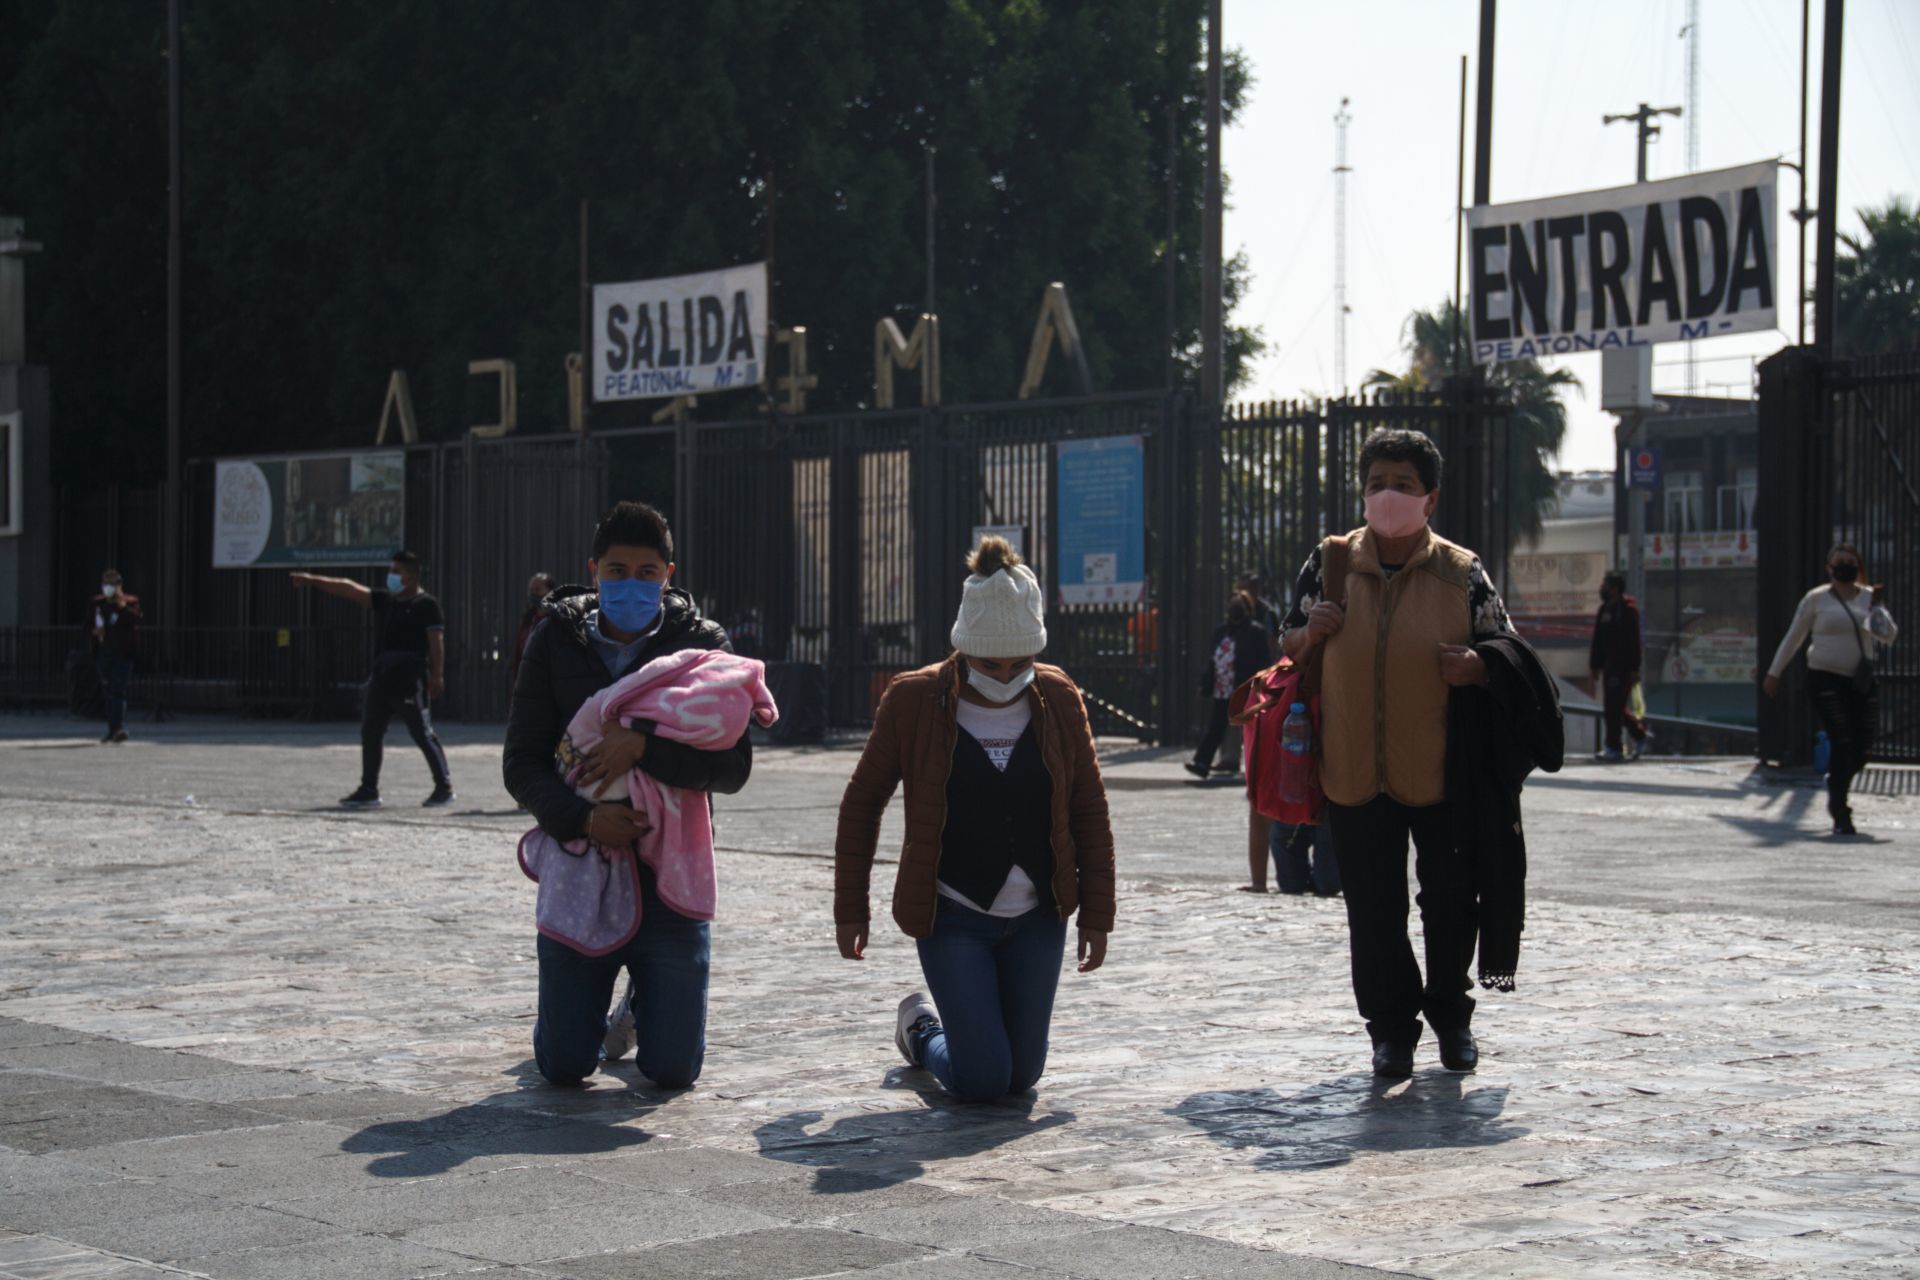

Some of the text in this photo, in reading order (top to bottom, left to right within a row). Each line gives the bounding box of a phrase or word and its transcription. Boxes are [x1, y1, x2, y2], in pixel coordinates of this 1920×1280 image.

[1472, 186, 1773, 339] ENTRADA
[606, 290, 756, 372] SALIDA
[1476, 329, 1649, 361] PEATONAL
[604, 372, 697, 396] PEATONAL
